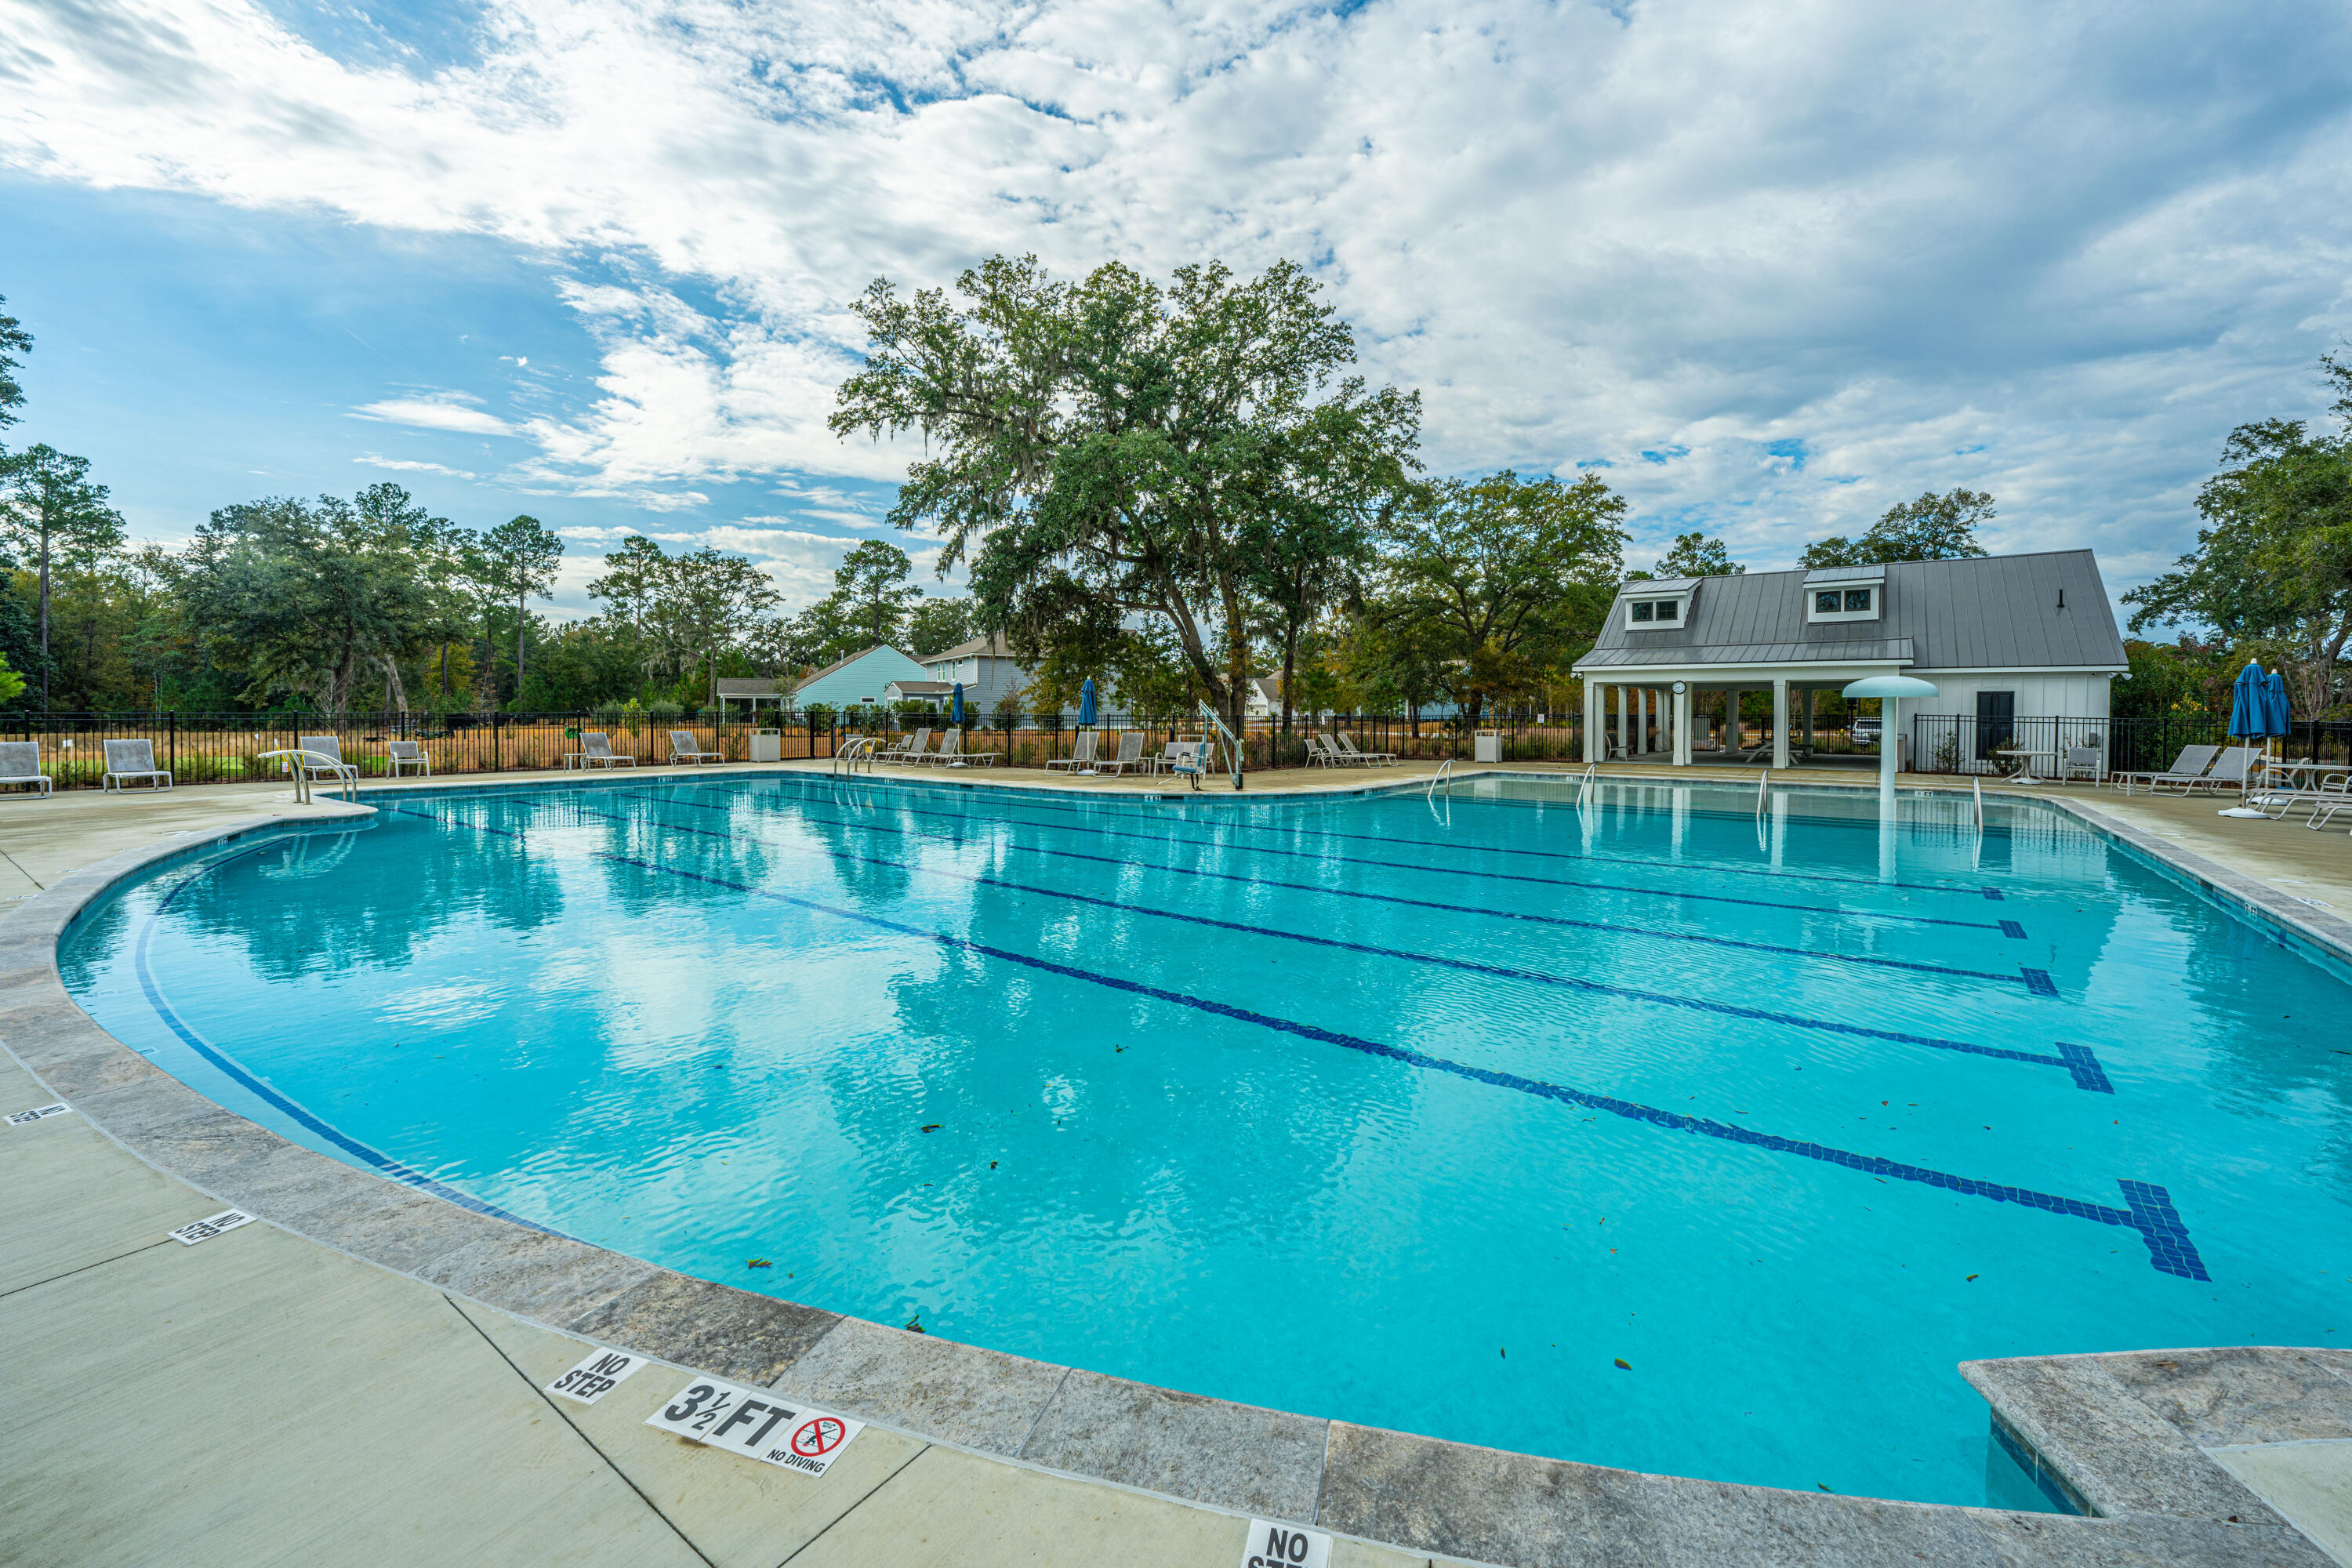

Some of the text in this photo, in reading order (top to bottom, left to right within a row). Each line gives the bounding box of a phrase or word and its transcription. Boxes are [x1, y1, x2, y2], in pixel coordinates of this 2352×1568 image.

[175, 1222, 221, 1240] STEP
[209, 1213, 245, 1227] NO
[590, 1352, 630, 1375] NO
[554, 1370, 616, 1398] STEP
[712, 1399, 796, 1447] FT
[766, 1449, 826, 1473] NO DIVING
[1266, 1527, 1308, 1563] NO
